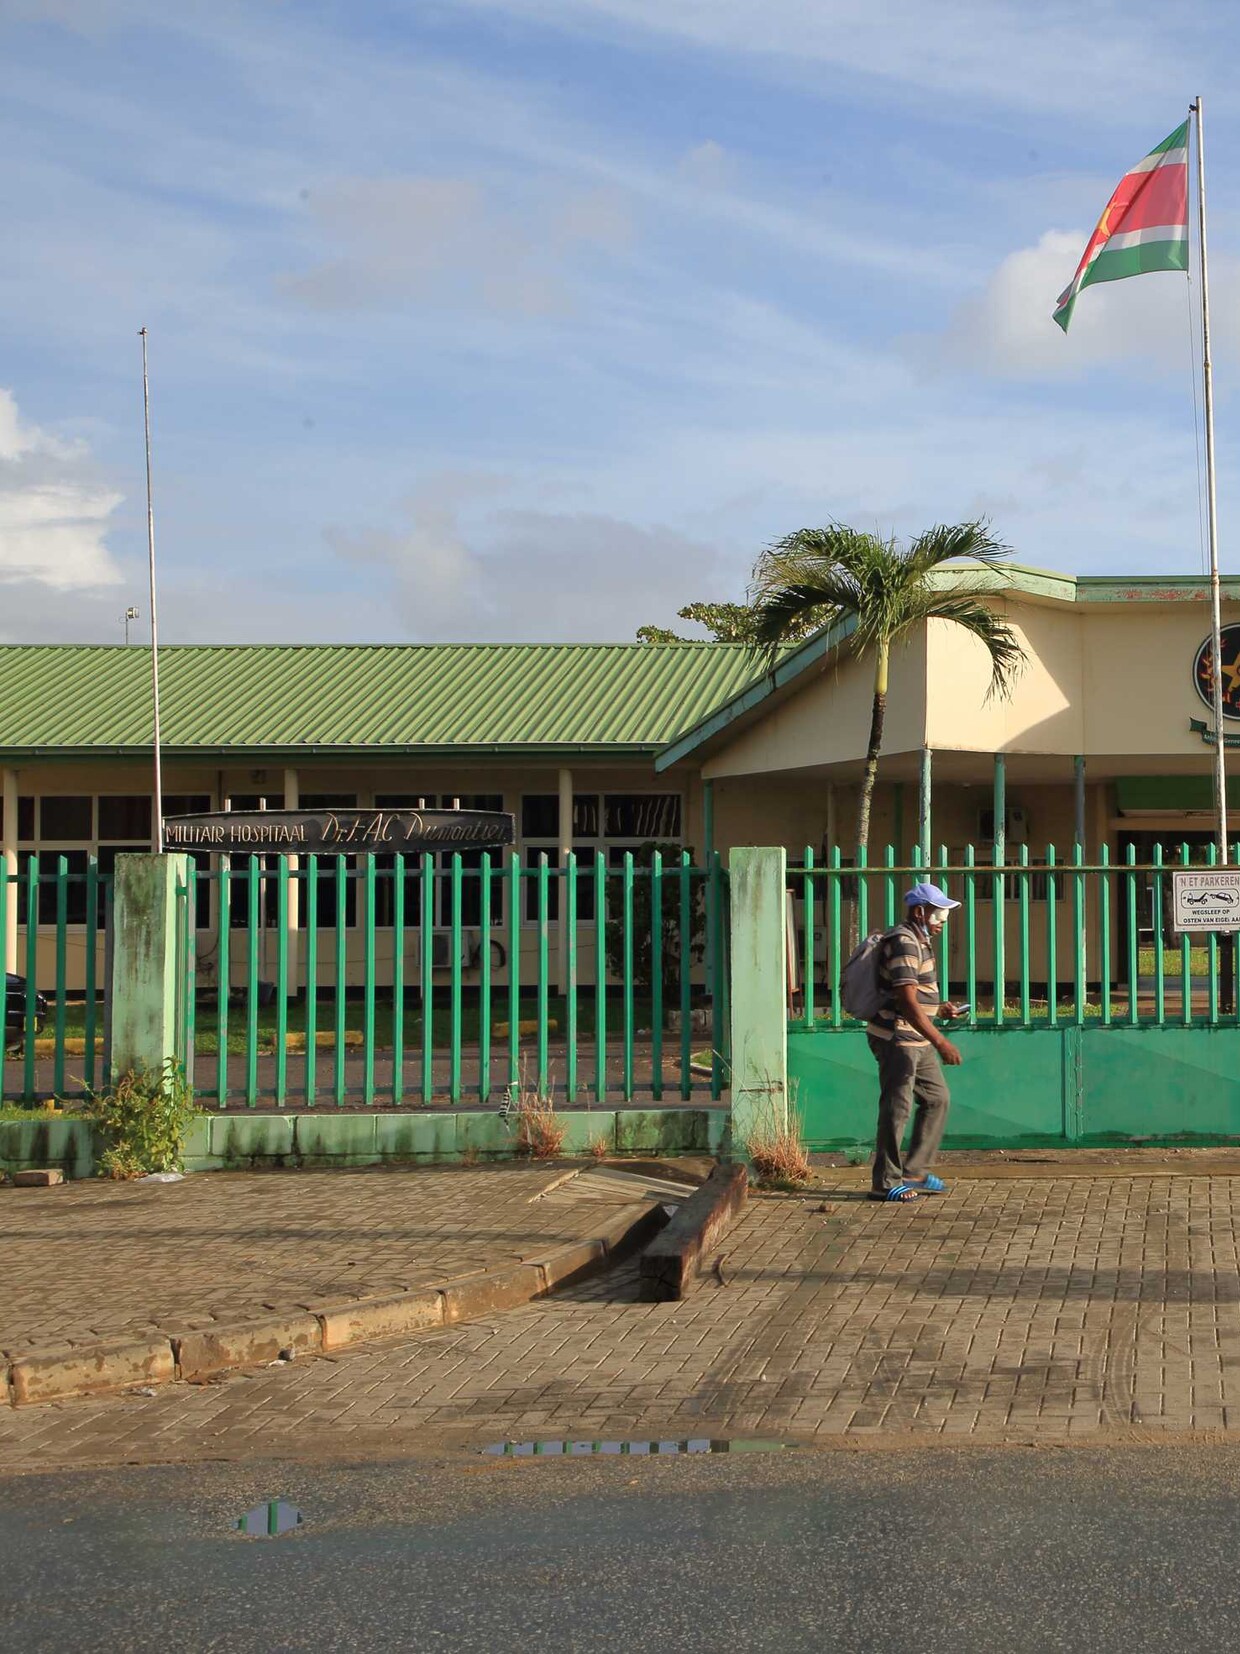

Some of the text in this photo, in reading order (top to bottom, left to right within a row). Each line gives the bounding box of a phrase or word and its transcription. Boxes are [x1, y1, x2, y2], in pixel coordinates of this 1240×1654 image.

[165, 825, 225, 843] MILITAIR
[230, 824, 309, 843] HOSPITAAL
[1180, 876, 1240, 887] NET PARKEREN
